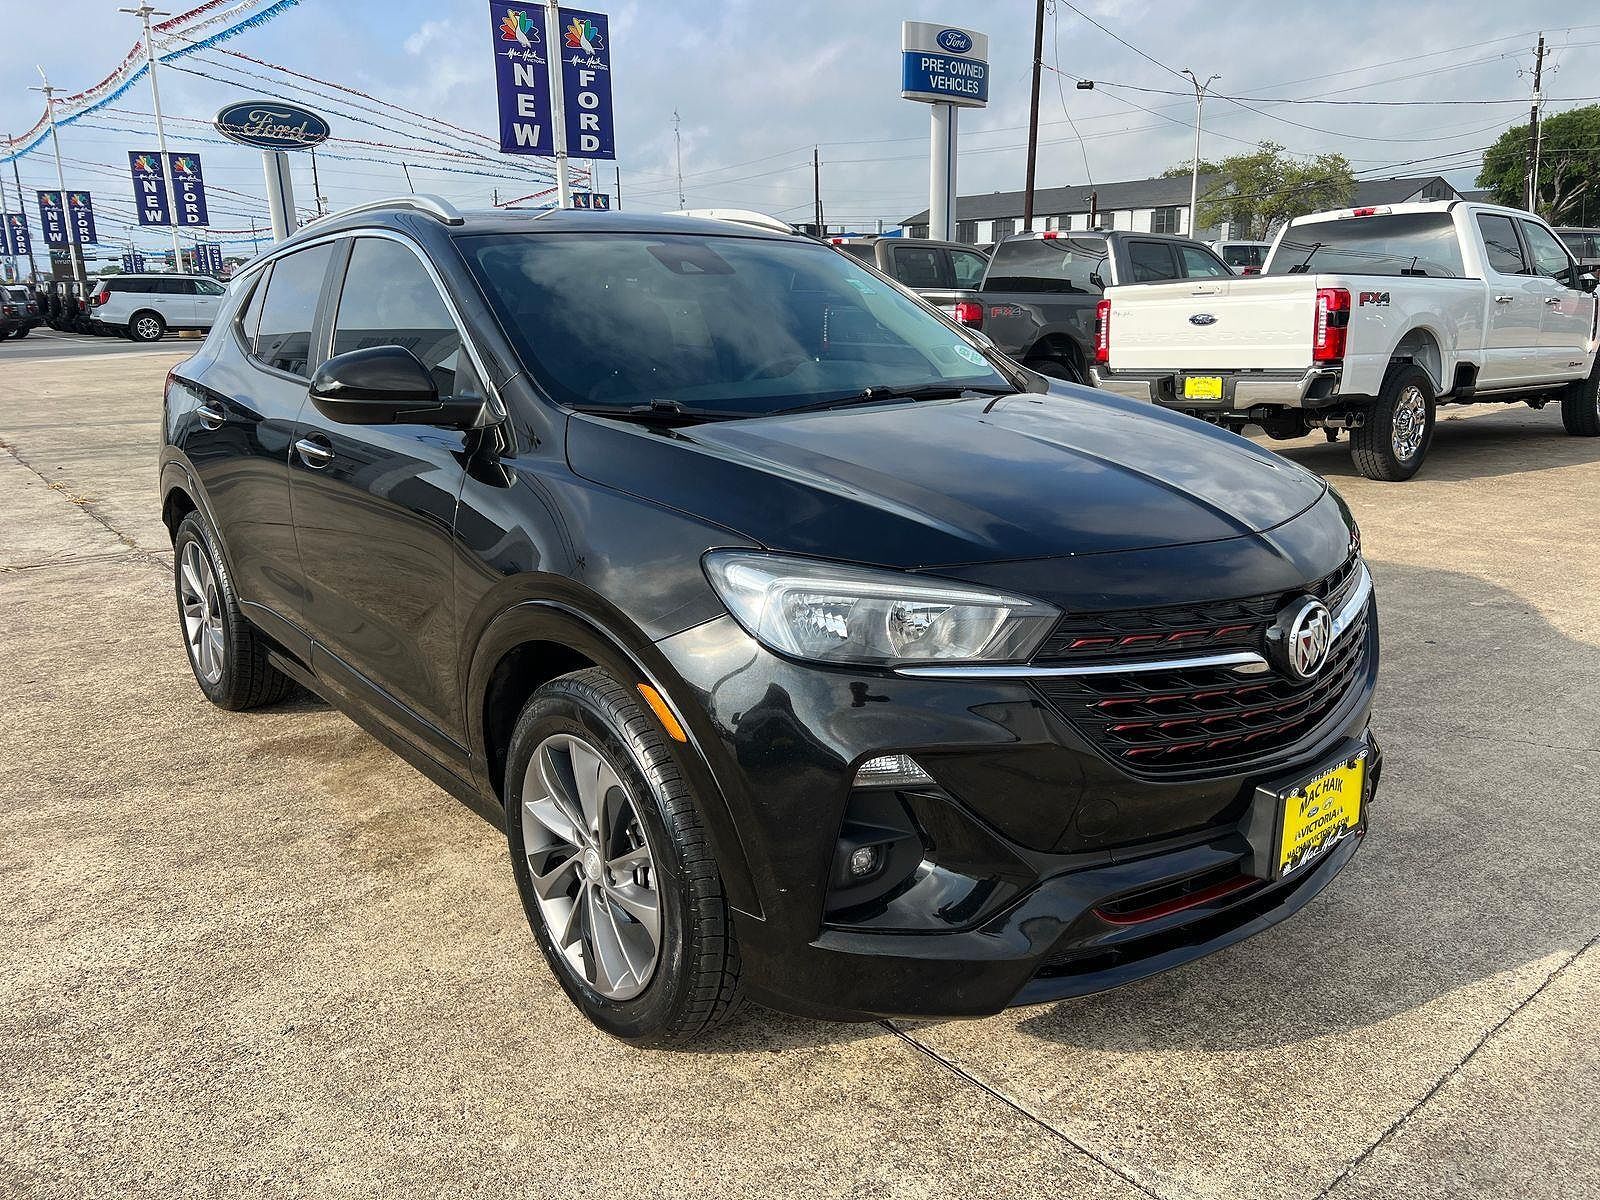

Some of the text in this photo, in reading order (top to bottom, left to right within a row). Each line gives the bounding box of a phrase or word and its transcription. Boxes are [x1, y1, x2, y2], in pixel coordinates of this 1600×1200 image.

[946, 32, 967, 48] Ford
[921, 57, 984, 79] PRE-OWNED
[929, 74, 979, 94] VEHICLES
[513, 62, 541, 148] NEW
[577, 69, 601, 153] FORD
[243, 109, 308, 140] Ford
[142, 180, 163, 222] NEW
[183, 182, 200, 223] FORD
[15, 230, 27, 254] FORD
[47, 211, 62, 242] NEW
[77, 212, 91, 243] FORD
[991, 305, 1024, 318] FX4
[1359, 291, 1391, 307] FX4
[1298, 783, 1322, 818] MAC
[1321, 776, 1344, 793] HAIK
[1301, 810, 1337, 838] VICTORIA
